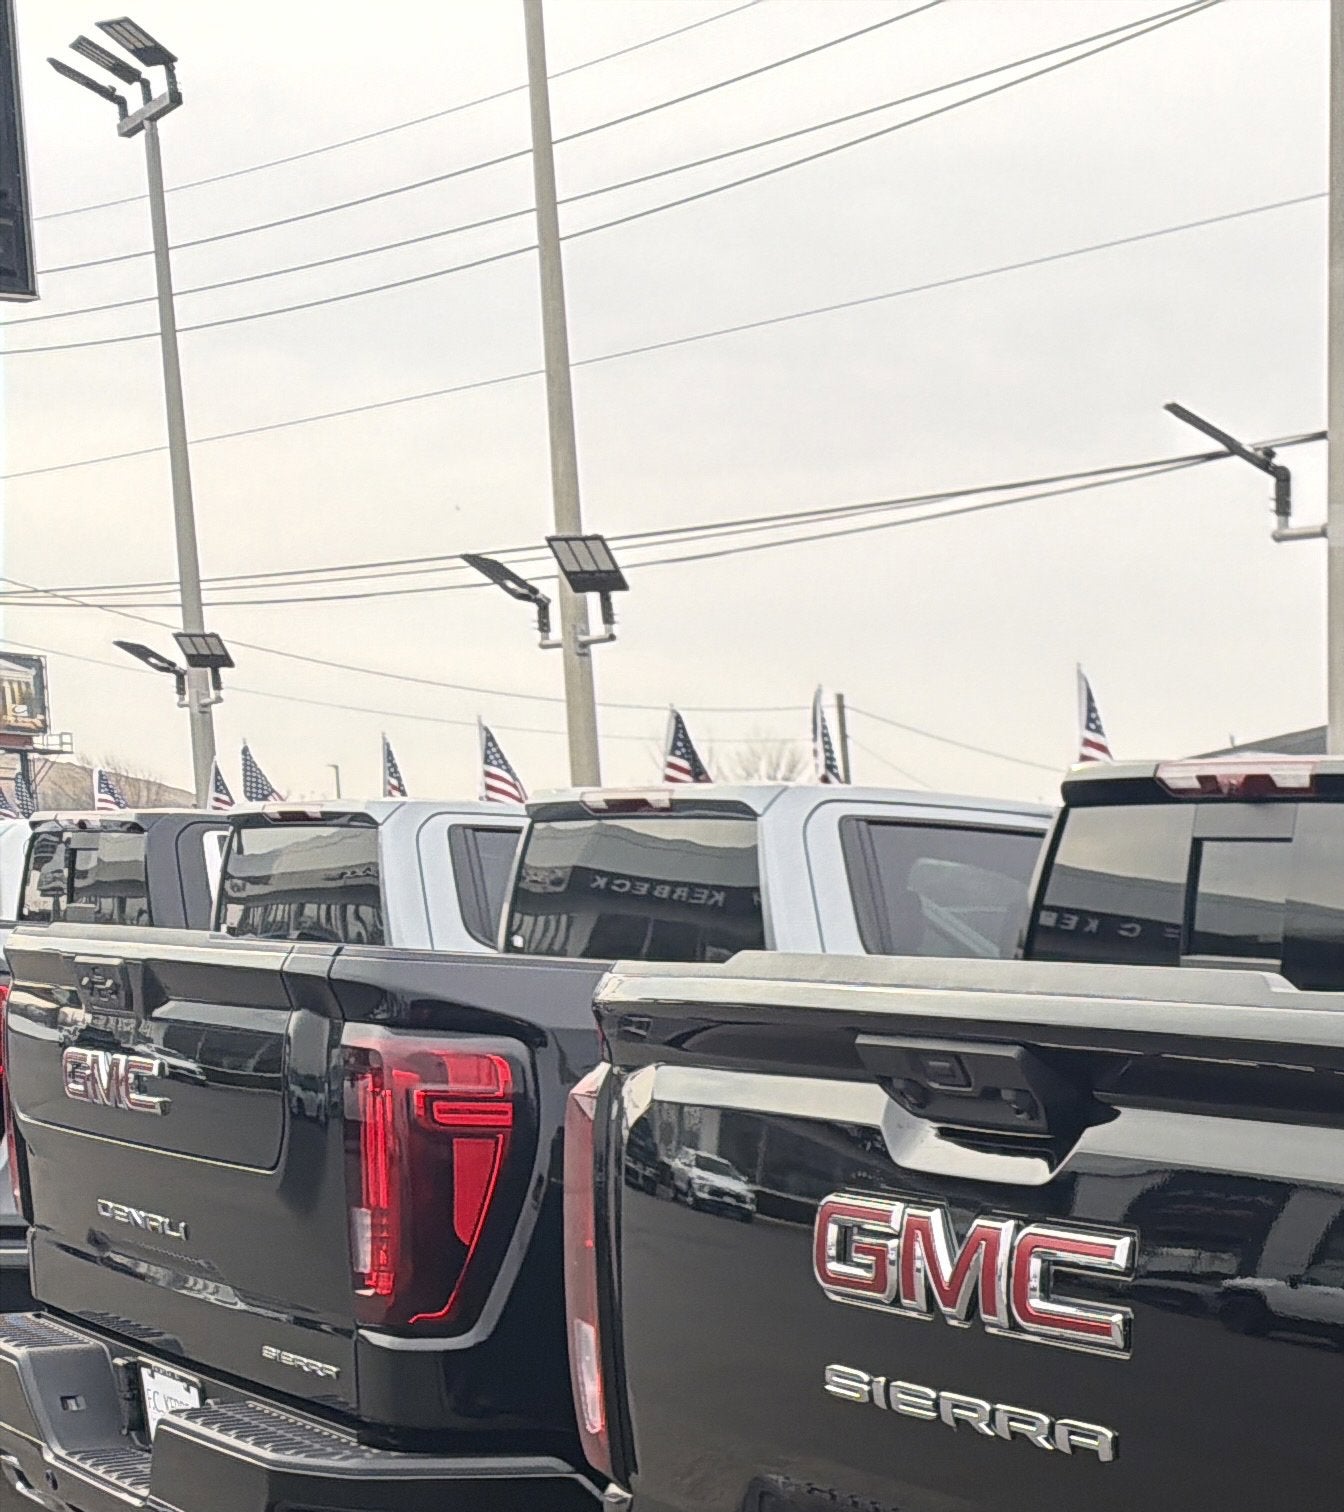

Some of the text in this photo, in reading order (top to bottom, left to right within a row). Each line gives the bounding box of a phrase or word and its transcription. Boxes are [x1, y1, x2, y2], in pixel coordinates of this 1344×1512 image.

[63, 1046, 172, 1116] GMC
[97, 1199, 190, 1241] DENALI
[814, 1191, 1139, 1358] GMC
[261, 1344, 341, 1381] SIERRA
[824, 1364, 1118, 1462] SIERRA
